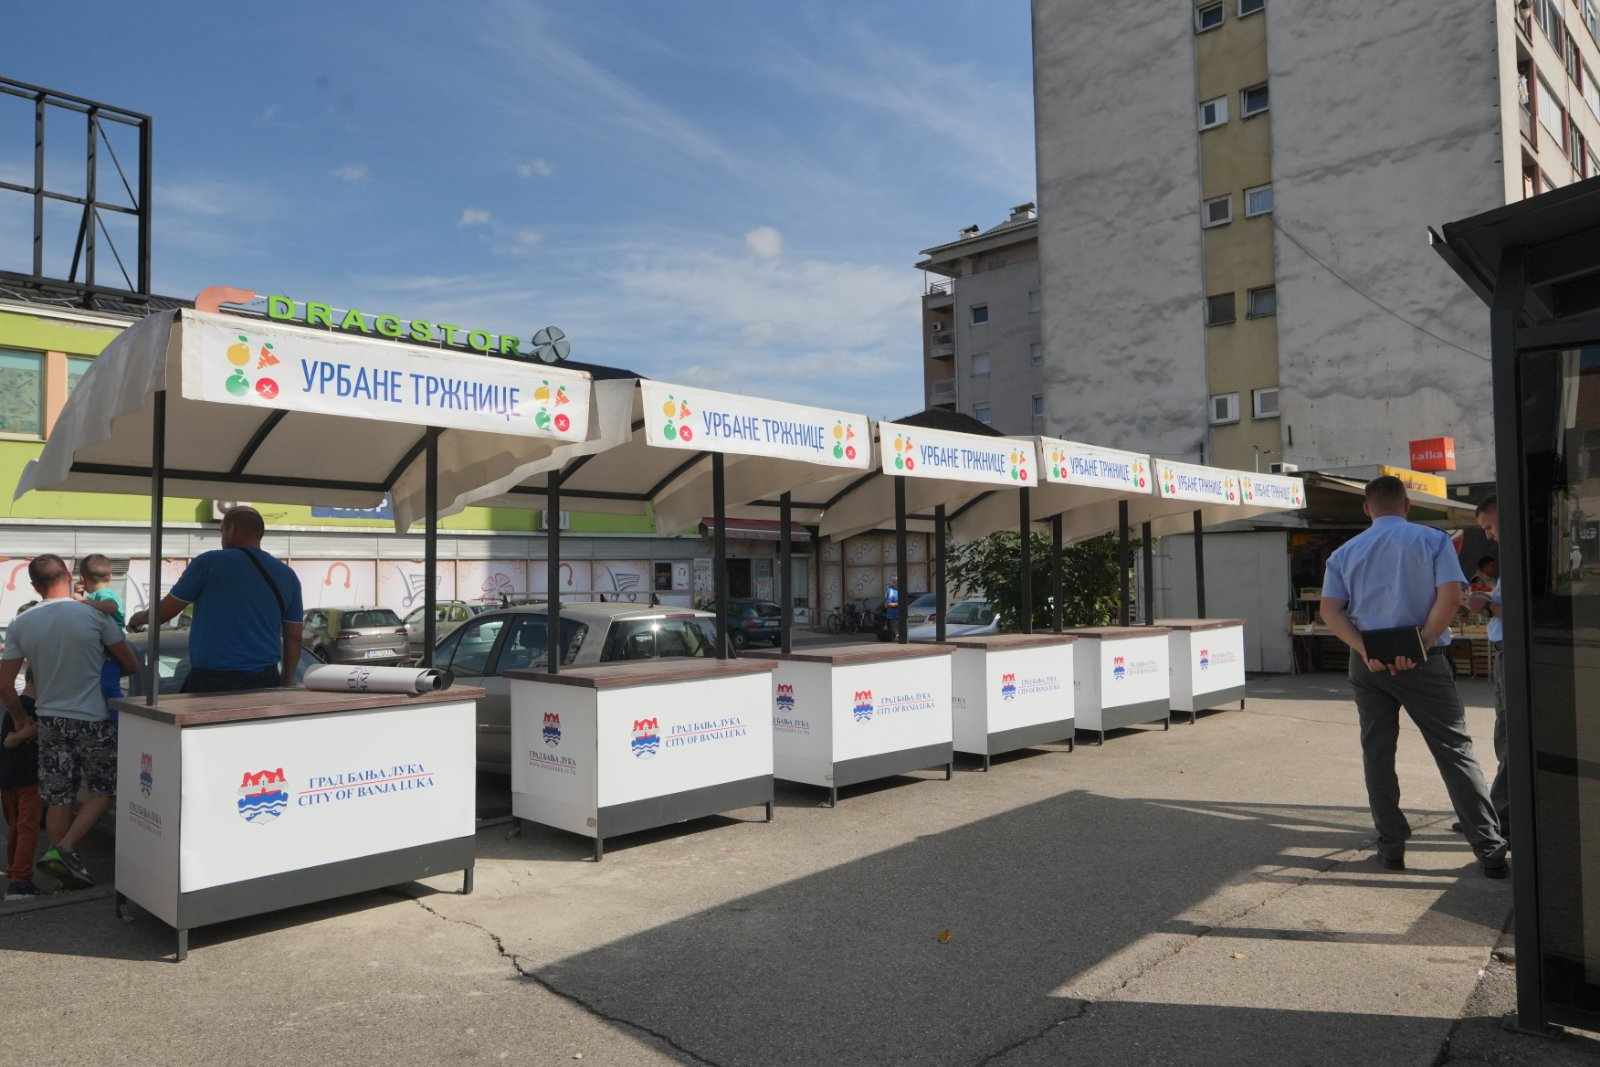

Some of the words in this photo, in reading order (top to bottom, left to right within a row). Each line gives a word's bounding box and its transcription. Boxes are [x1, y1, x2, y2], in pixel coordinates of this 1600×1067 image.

[267, 294, 521, 355] DRAGSTOR
[301, 358, 402, 403] УРБАНЕ
[410, 373, 521, 421] ТРЖНИЦЕ
[702, 410, 760, 441] УРБАНЕ
[762, 418, 824, 453] ТРЖНИЦЕ
[920, 444, 959, 468] УРБАНЕ
[961, 449, 1005, 475] ТРЖНИЦЕ
[1070, 456, 1098, 477] УРБАНЕ
[1099, 460, 1130, 482] ТРЖНИЦЕ
[665, 737, 685, 747] CITY
[687, 736, 697, 744] OF
[699, 731, 724, 743] BANJA
[725, 728, 746, 738] LUKA
[671, 724, 692, 734] ГРАД
[694, 721, 717, 731] БАЊА
[719, 716, 741, 727] ЛУКА
[309, 773, 345, 789] ГРАД
[348, 769, 387, 783] БАЊА
[388, 763, 425, 777] ЛУКА
[298, 792, 333, 806] CITY
[335, 789, 353, 801] OF
[357, 783, 397, 798] BANJA
[400, 777, 435, 791] LUKA
